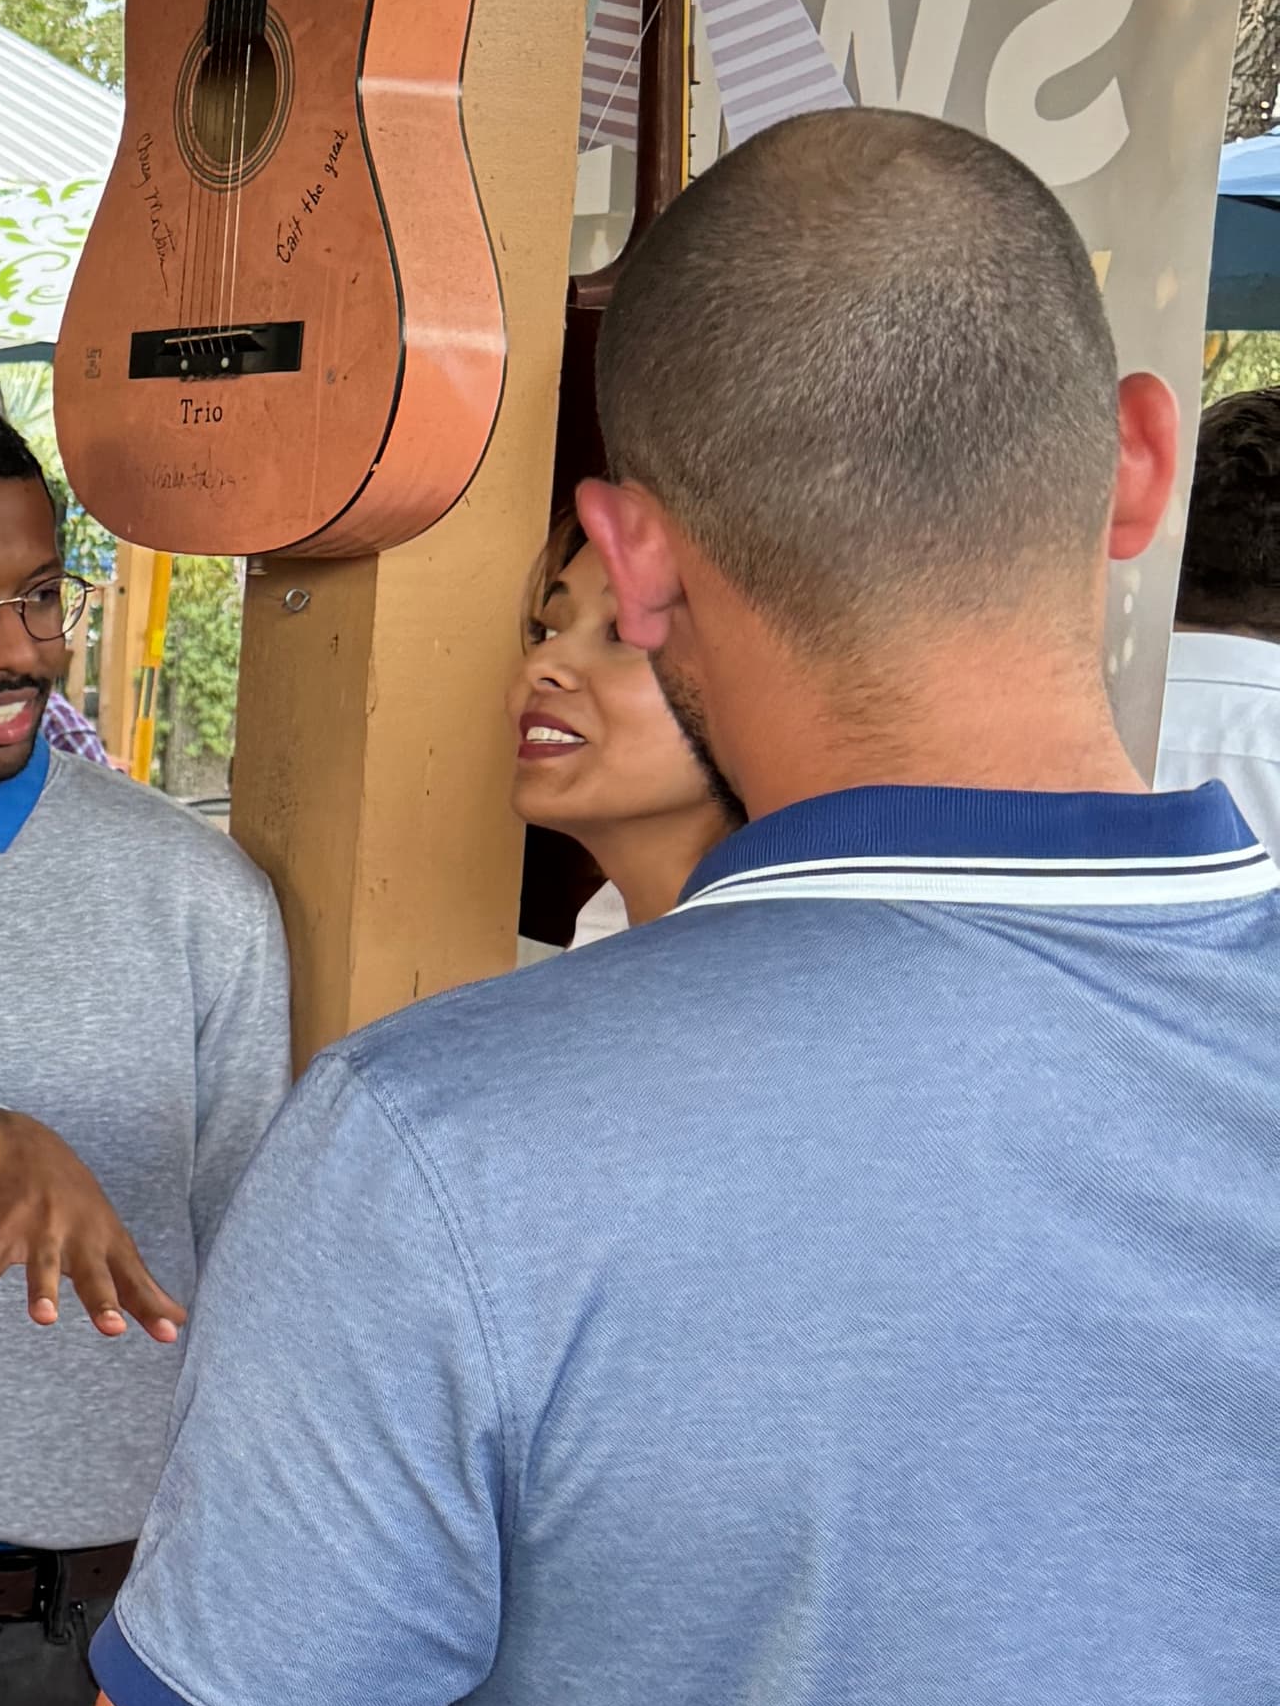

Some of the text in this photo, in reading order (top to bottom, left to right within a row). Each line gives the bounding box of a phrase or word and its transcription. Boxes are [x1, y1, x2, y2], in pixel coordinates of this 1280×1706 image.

[301, 183, 325, 214] the
[324, 129, 349, 179] great
[180, 398, 223, 424] Trio
